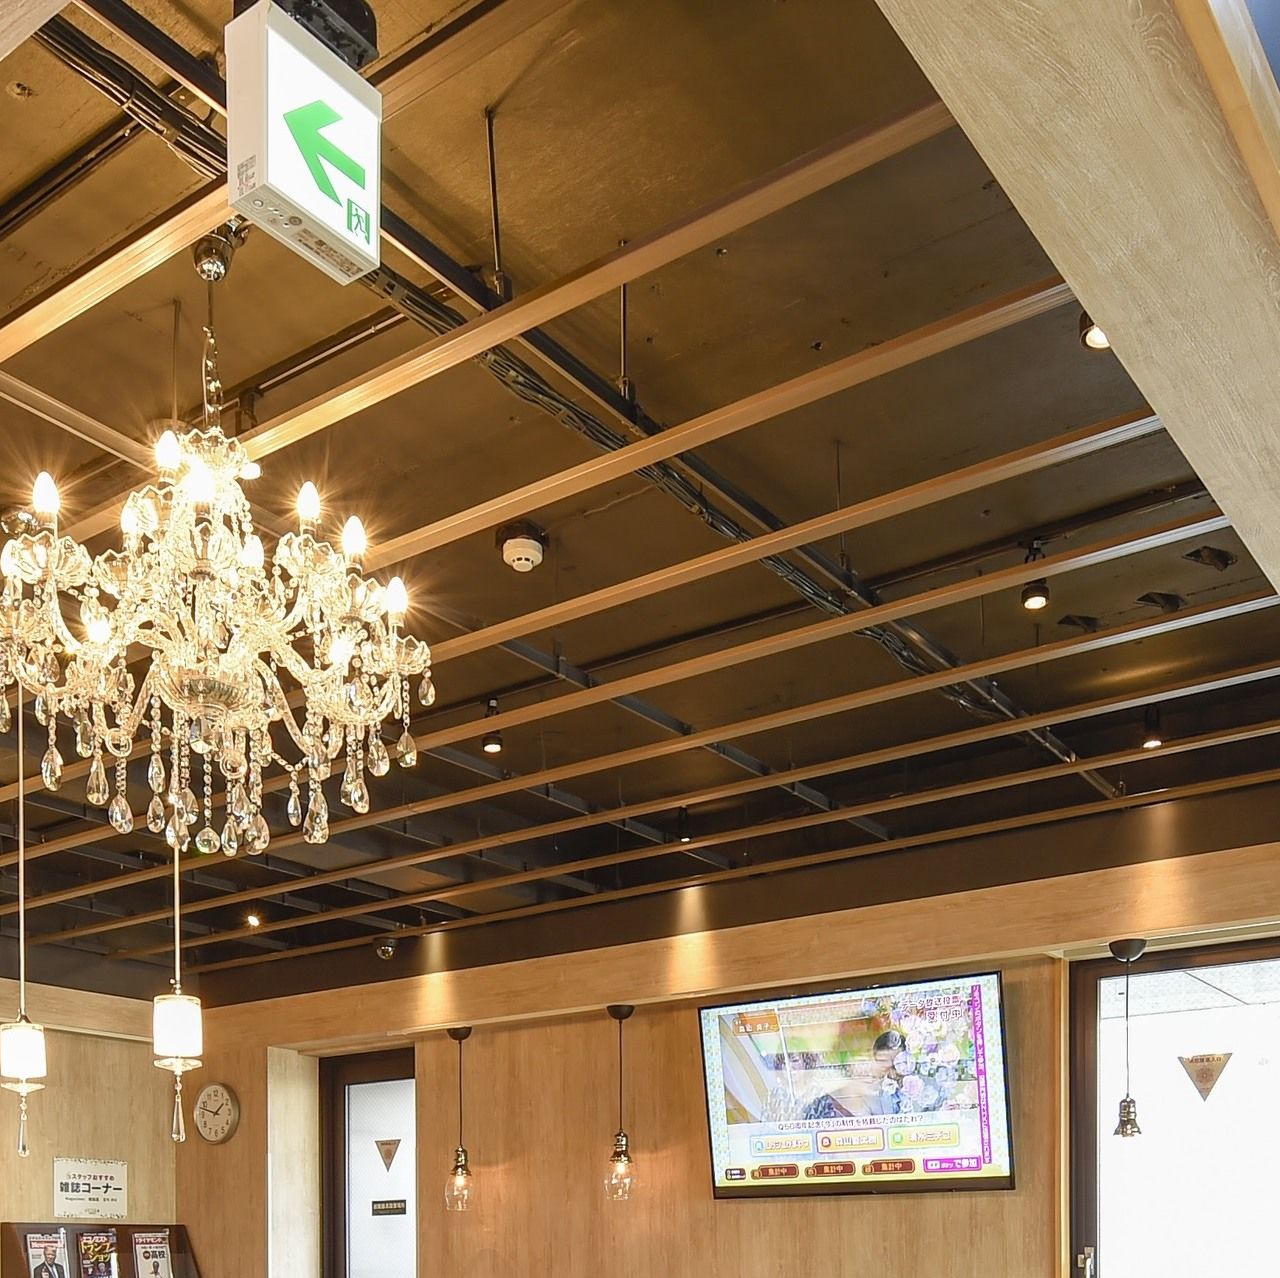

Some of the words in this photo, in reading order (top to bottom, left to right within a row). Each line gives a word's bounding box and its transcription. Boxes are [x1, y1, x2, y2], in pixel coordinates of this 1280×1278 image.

[59, 1182, 123, 1194] 雑誌コーナー
